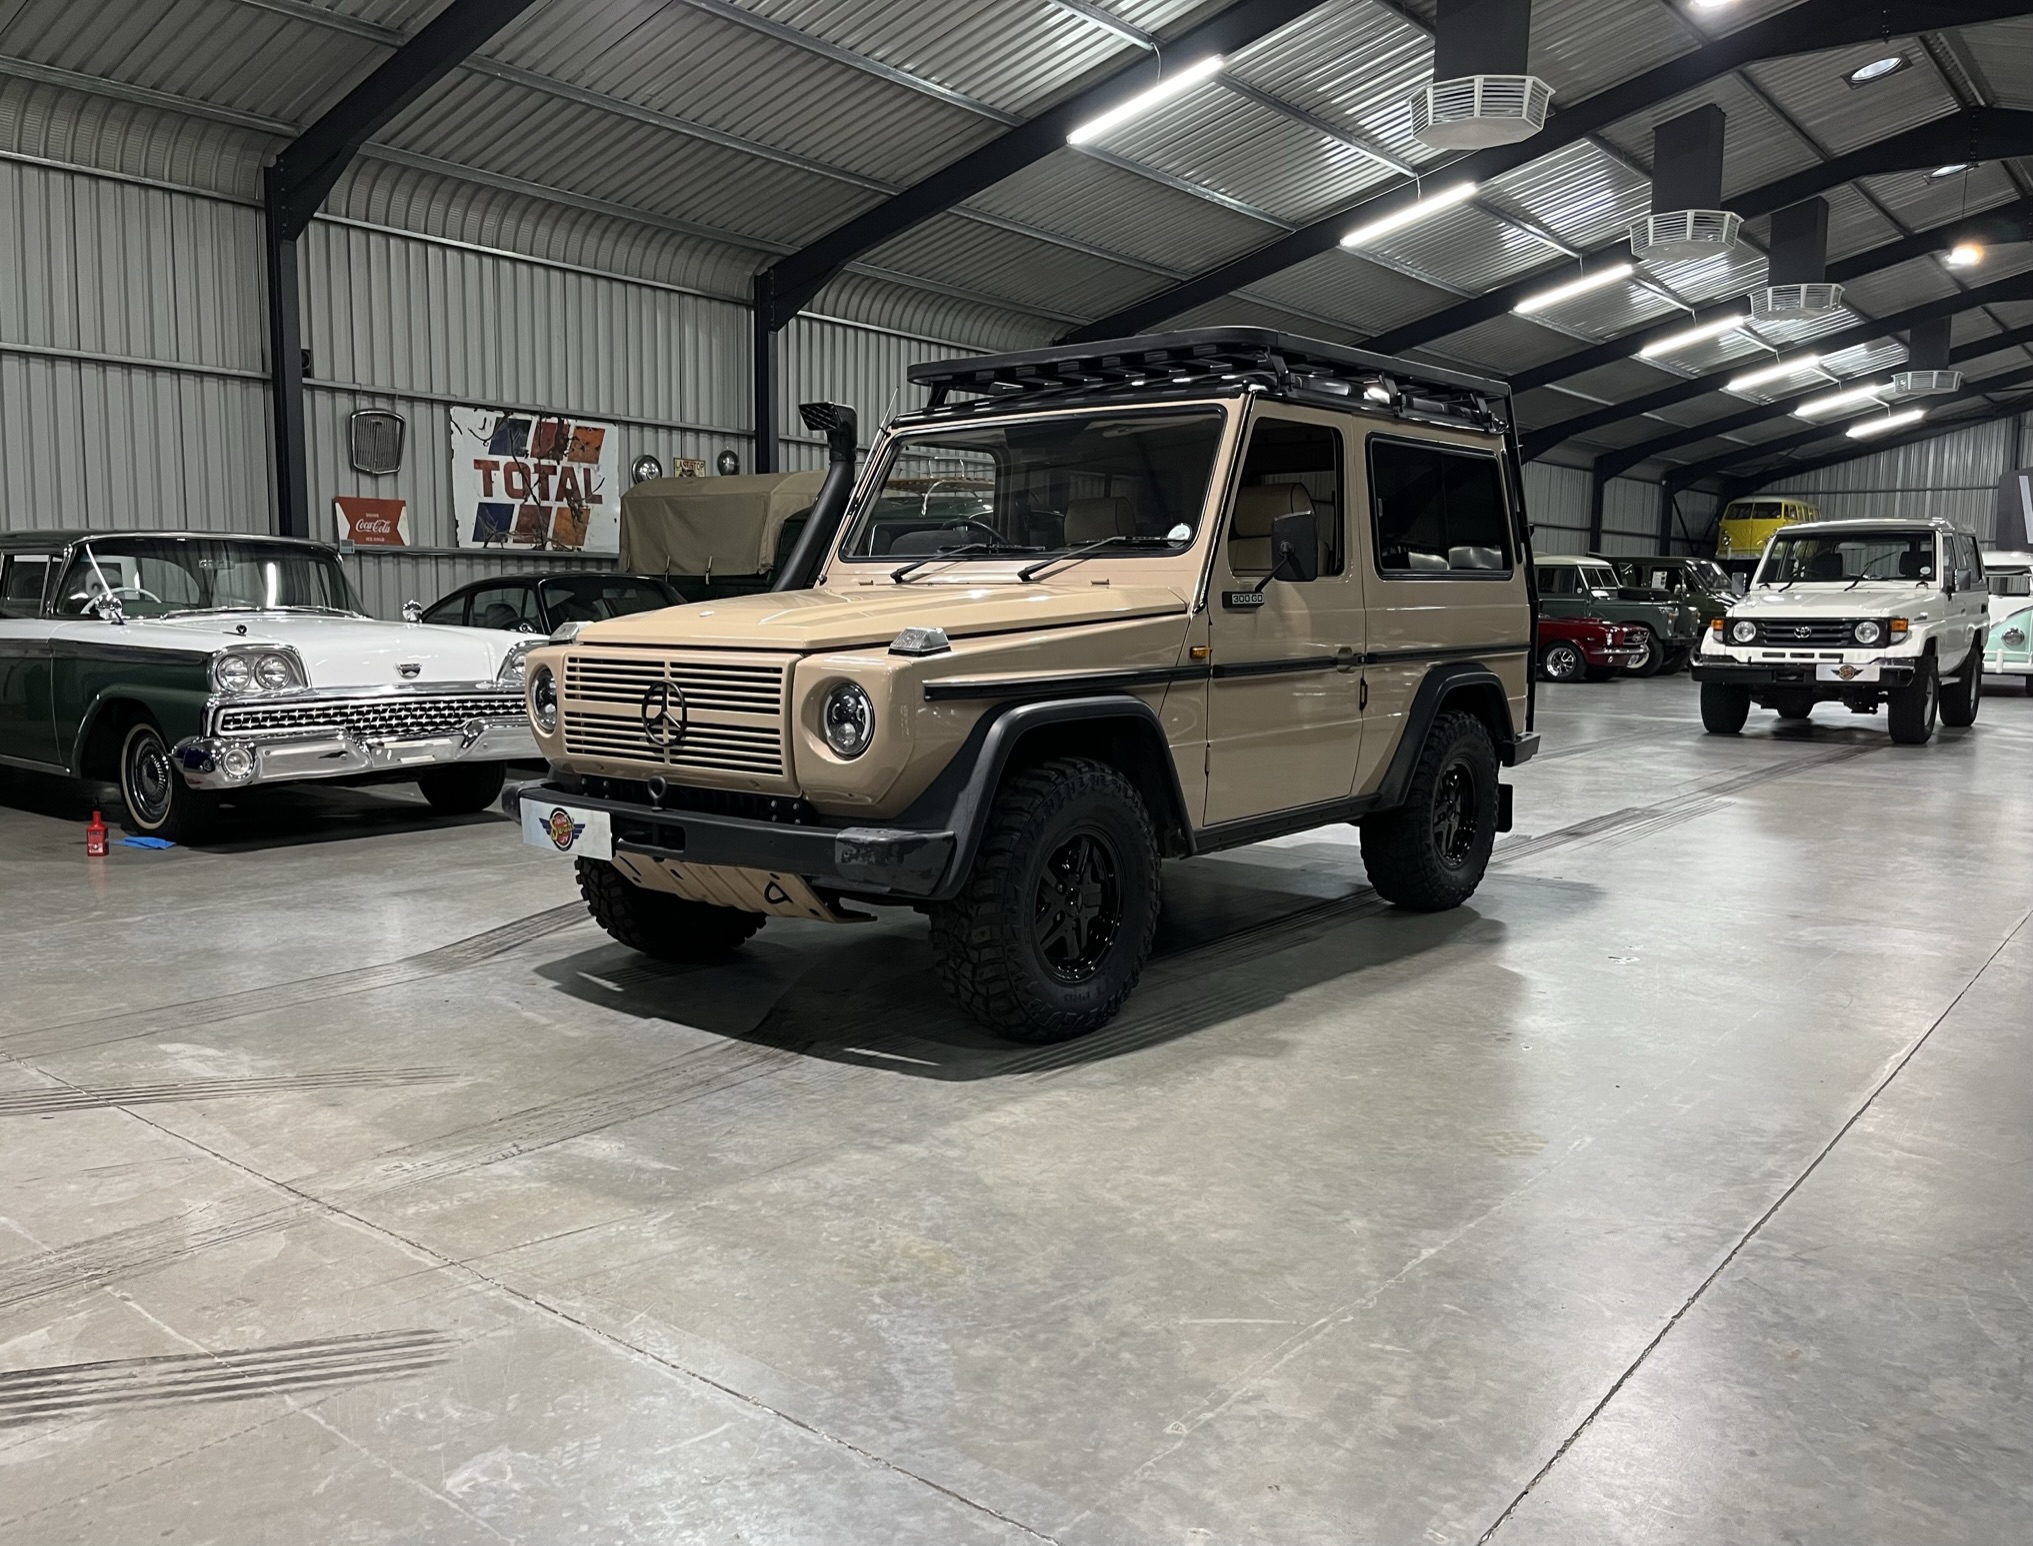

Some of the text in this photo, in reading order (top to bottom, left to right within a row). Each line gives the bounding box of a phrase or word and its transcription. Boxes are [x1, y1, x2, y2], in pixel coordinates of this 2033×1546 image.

[473, 459, 603, 504] TOTAL
[355, 518, 391, 533] Coca-Cola
[1233, 594, 1263, 603] 300 GD
